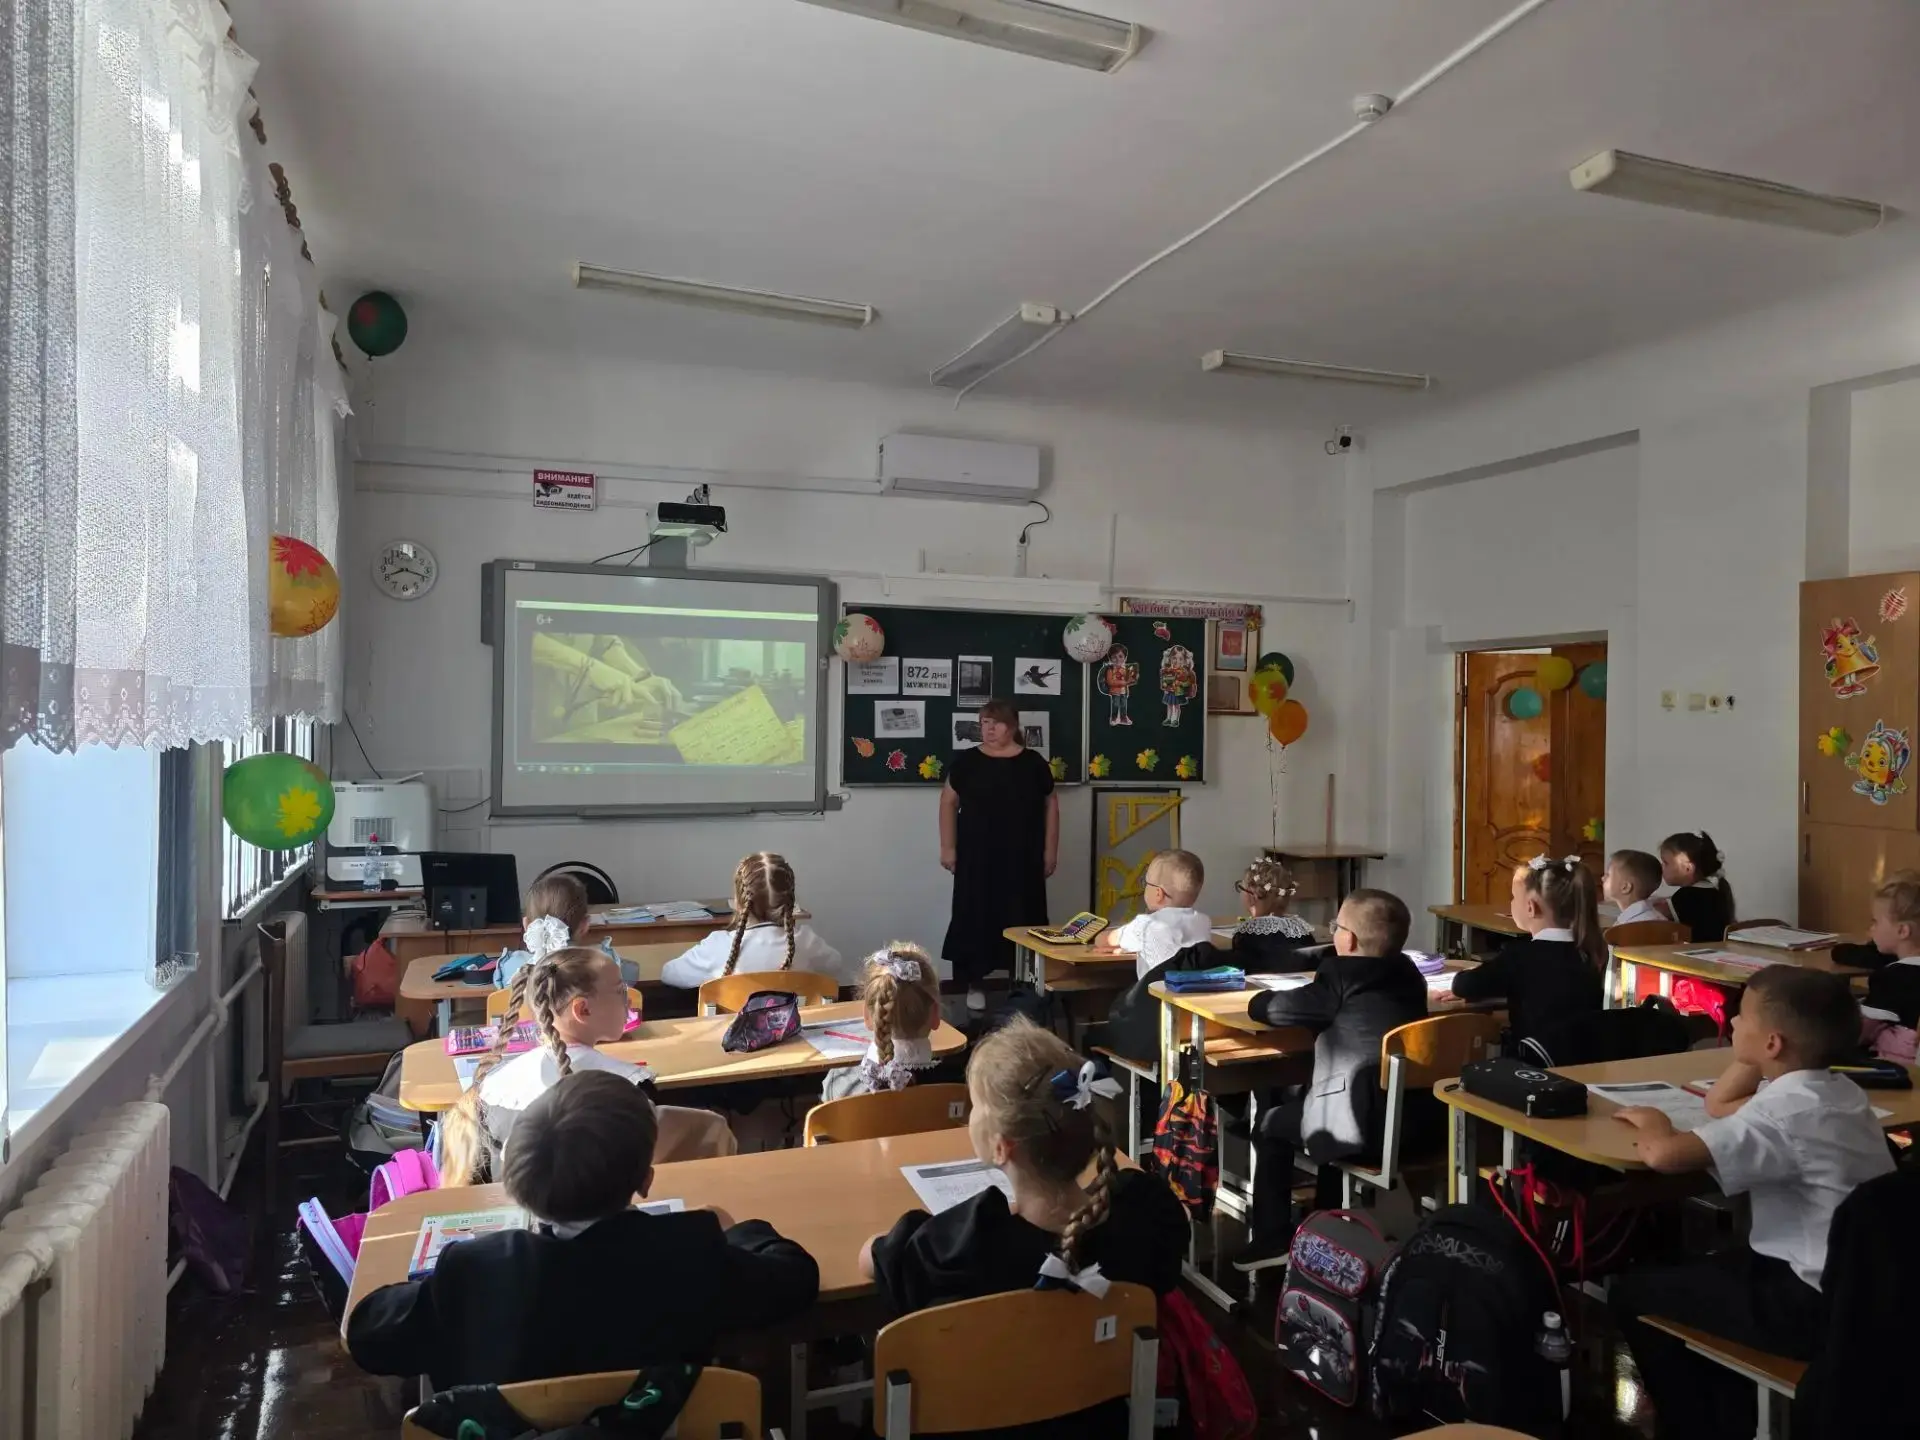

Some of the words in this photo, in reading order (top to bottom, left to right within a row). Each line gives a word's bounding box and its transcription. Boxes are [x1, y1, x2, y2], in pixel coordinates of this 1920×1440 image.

[537, 472, 592, 484] ВНИМАНИЕ
[384, 573, 391, 582] 8
[401, 584, 409, 592] 6
[536, 613, 554, 626] 6+
[907, 666, 930, 679] 872
[1436, 1328, 1447, 1370] FAST
